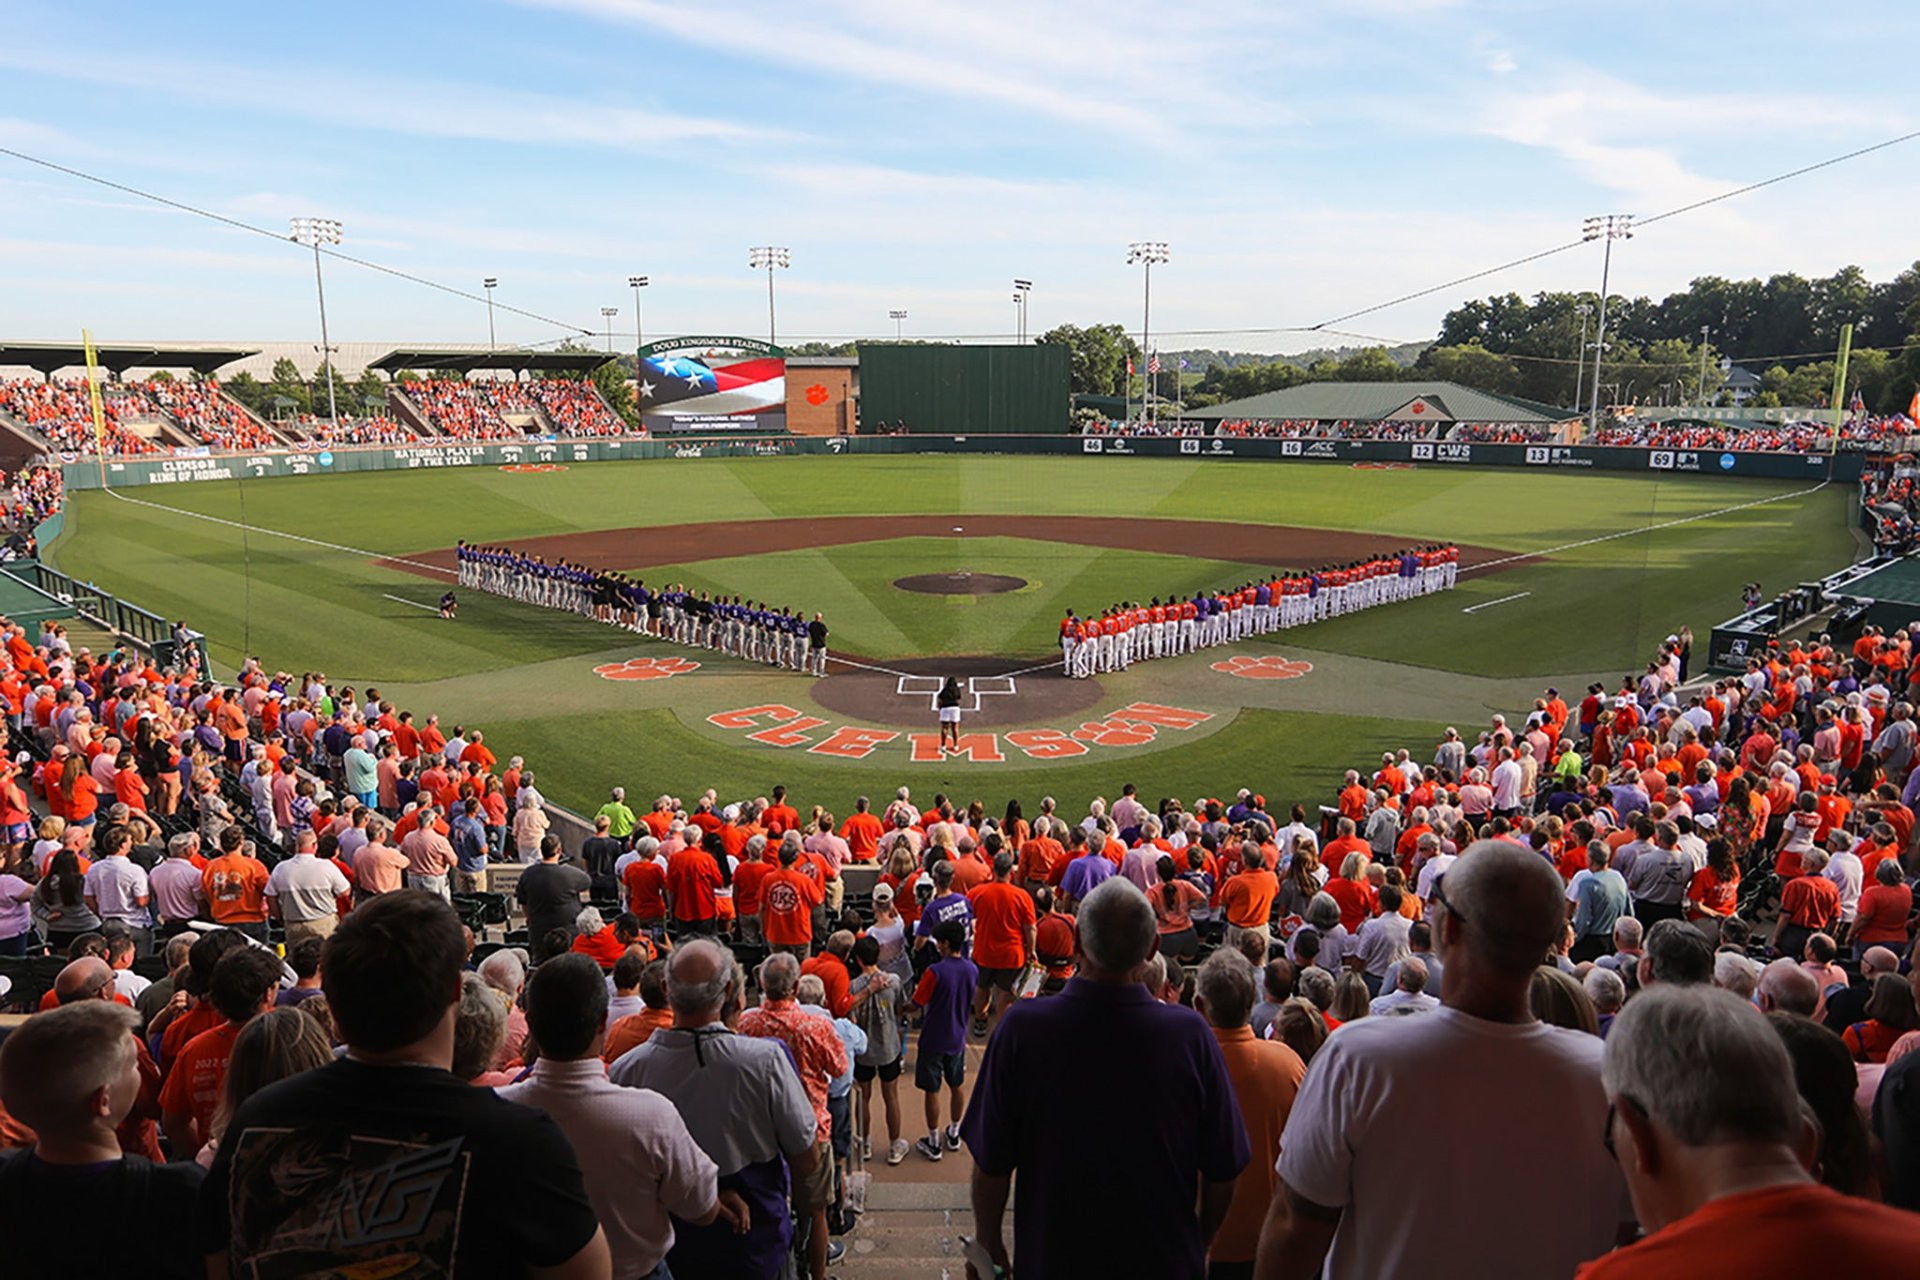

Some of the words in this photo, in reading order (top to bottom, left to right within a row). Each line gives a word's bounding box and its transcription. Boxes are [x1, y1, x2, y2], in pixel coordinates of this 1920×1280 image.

[652, 340, 679, 352] DOUG
[681, 338, 731, 347] KINGSMORE
[732, 339, 771, 353] STADIUM
[832, 444, 841, 453] 7
[1086, 440, 1100, 451] 46
[1183, 441, 1197, 451] 66
[1285, 442, 1299, 454] 16
[1307, 442, 1336, 452] ACC
[1414, 445, 1431, 457] 12
[1437, 444, 1470, 457] CWS
[394, 448, 445, 459] NATIONAL
[447, 446, 485, 457] PLAYER
[540, 452, 551, 461] 14
[1531, 448, 1545, 461] 13
[408, 458, 421, 468] OF
[423, 457, 444, 467] THE
[445, 456, 472, 466] YEAR
[1653, 453, 1670, 466] 69
[149, 472, 175, 484] RING
[178, 471, 191, 481] OF
[194, 468, 232, 480] HONOR
[256, 466, 264, 476] 3
